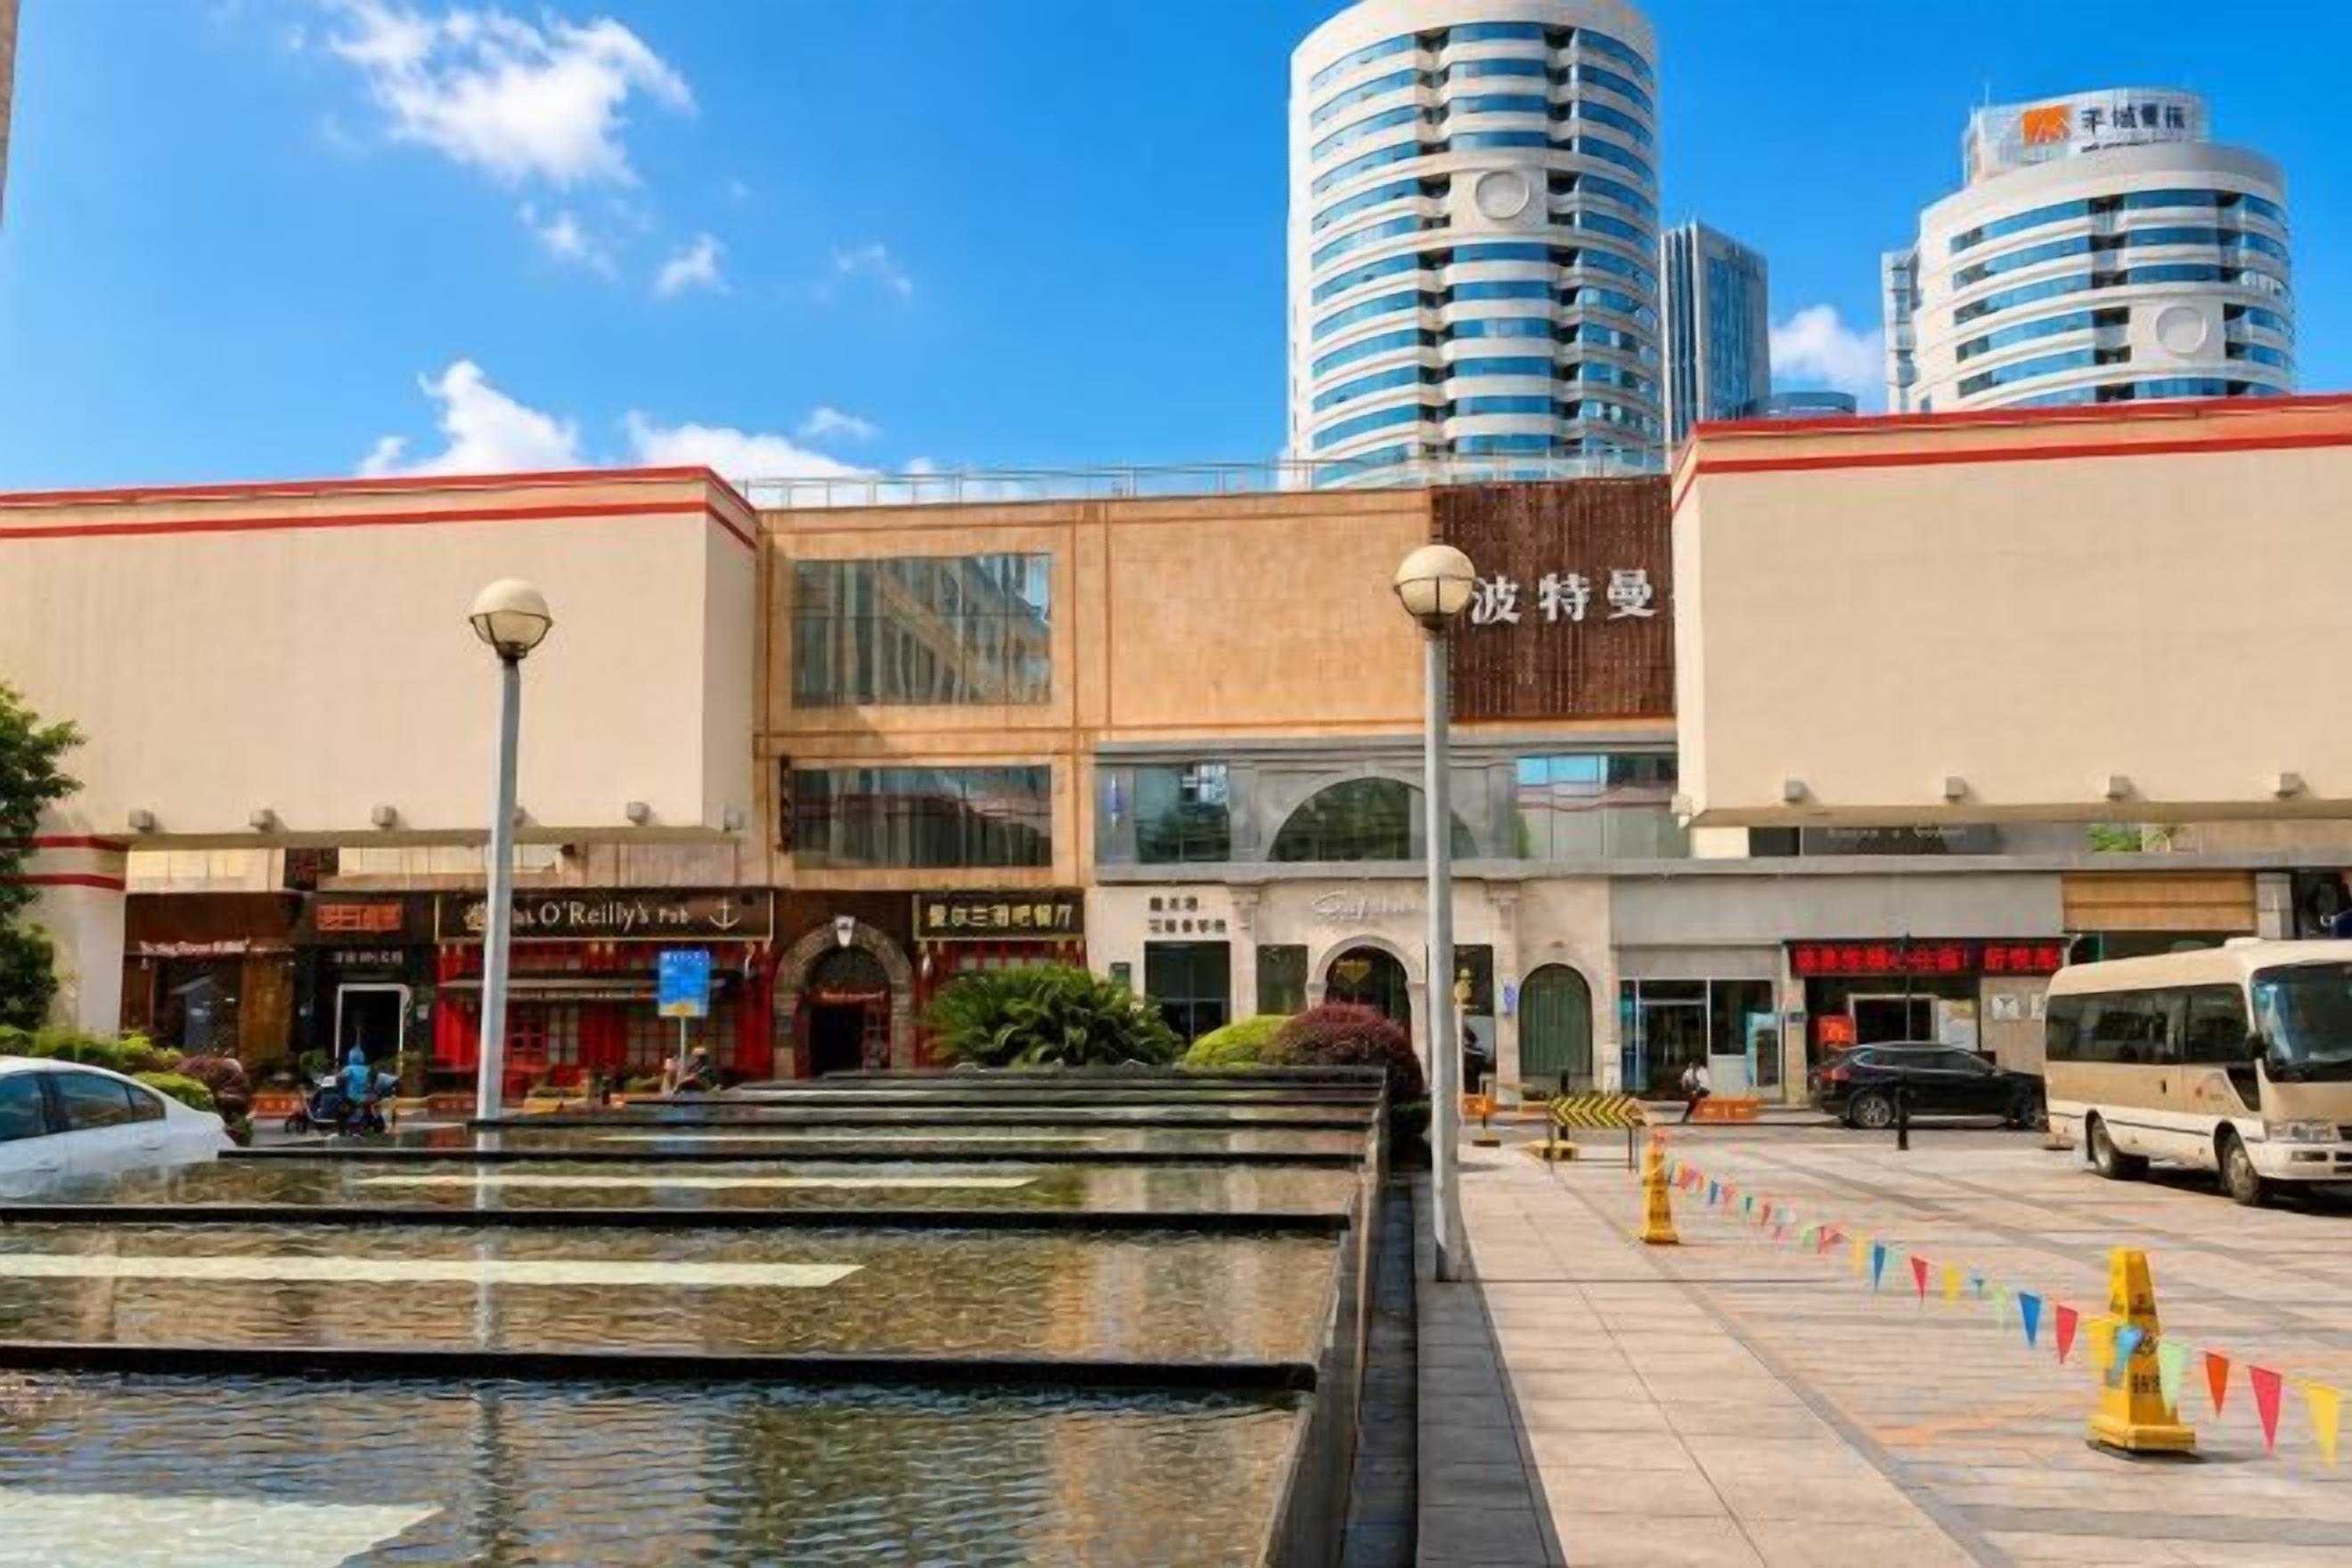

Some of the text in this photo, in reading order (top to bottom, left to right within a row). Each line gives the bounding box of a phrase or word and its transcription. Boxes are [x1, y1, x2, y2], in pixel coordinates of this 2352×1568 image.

[1472, 568, 1660, 624] 波特曼
[540, 898, 649, 932] O'Reilly's
